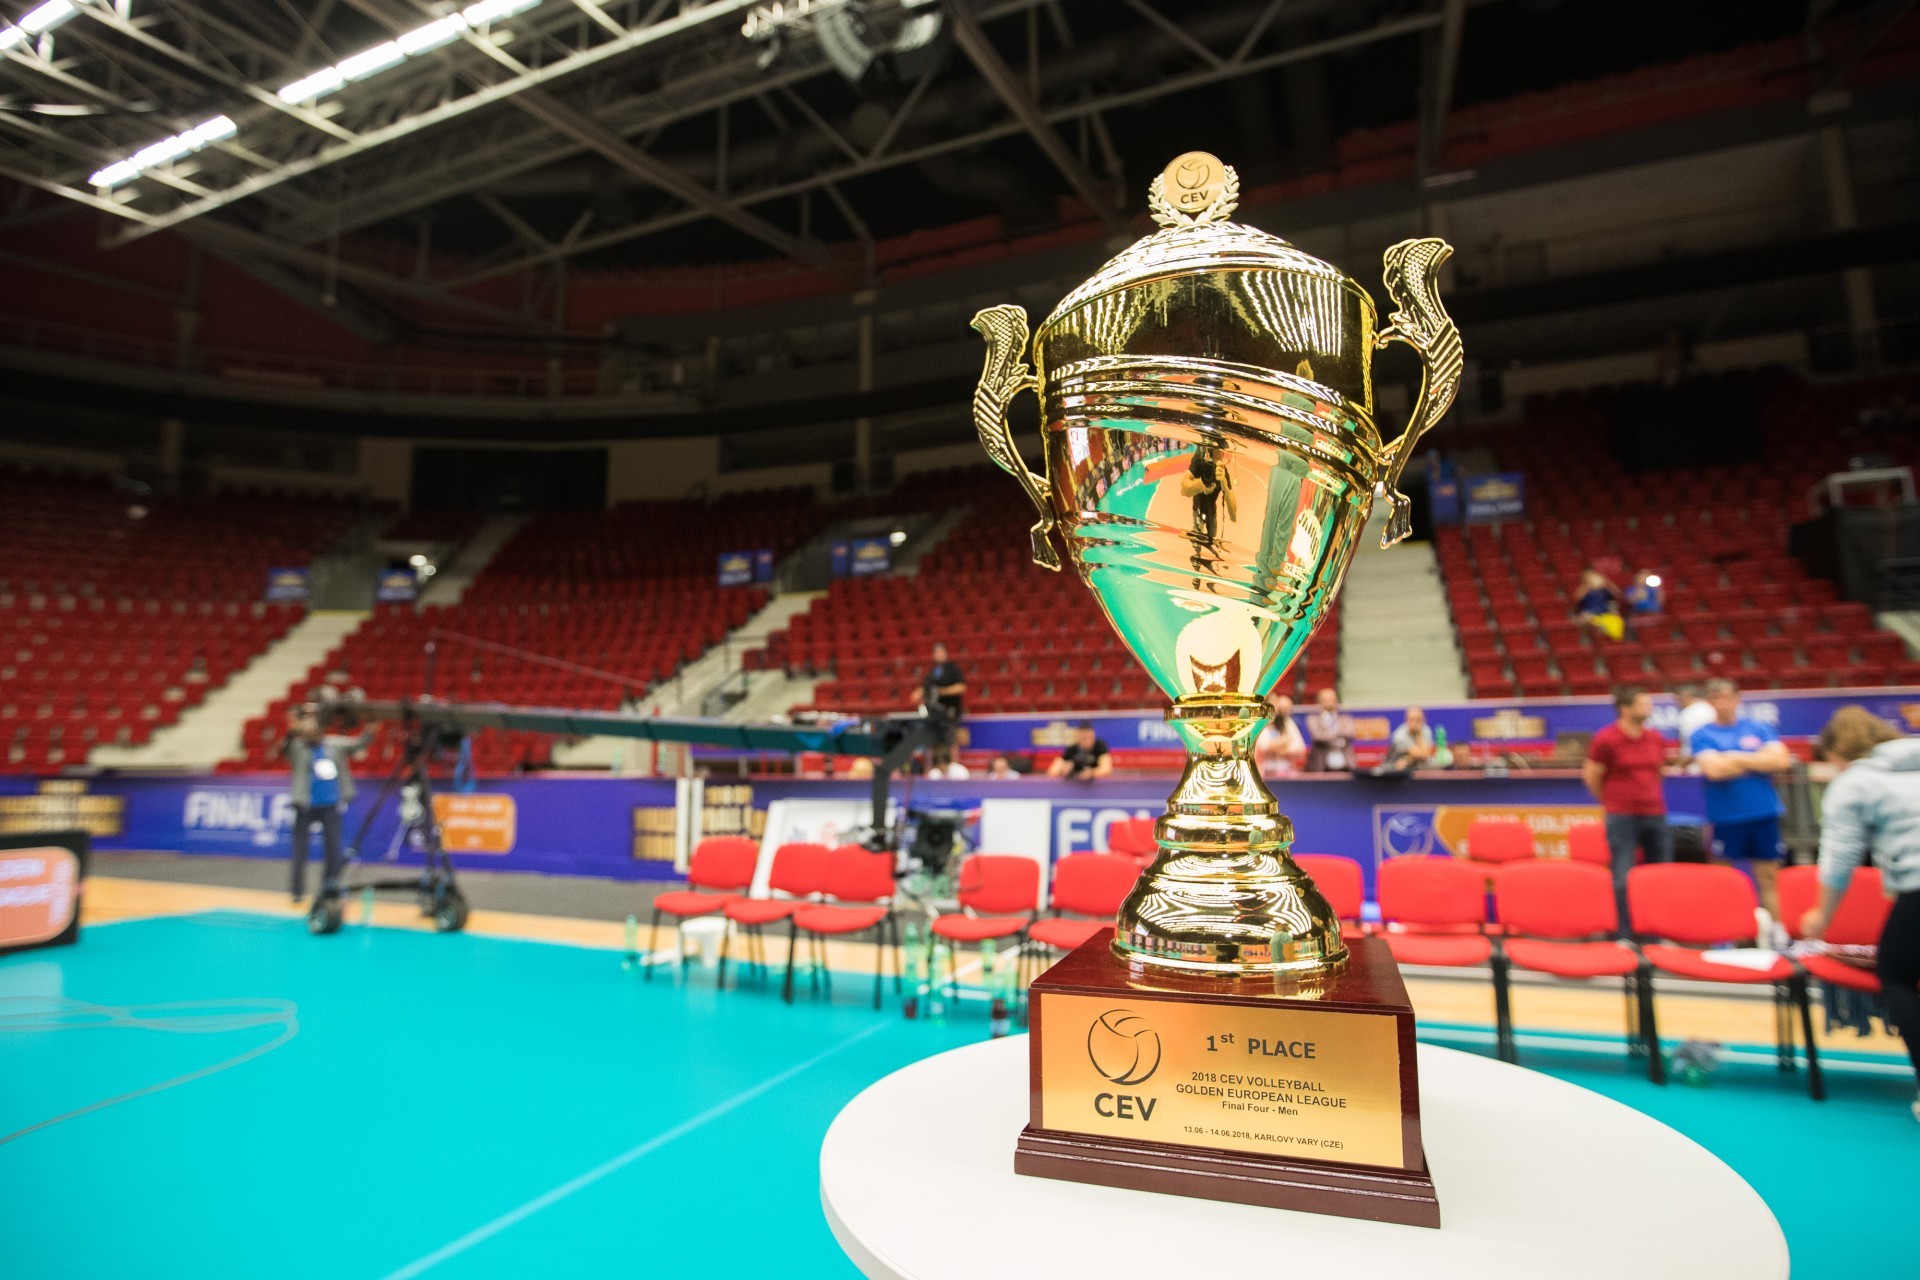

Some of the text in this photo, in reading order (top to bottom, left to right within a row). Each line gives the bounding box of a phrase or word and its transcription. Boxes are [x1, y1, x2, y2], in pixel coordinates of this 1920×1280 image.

[1180, 190, 1209, 204] CEV
[1207, 1033, 1316, 1059] 1st PLACE
[1191, 1072, 1325, 1092] 2018 CEV VOLLEYBALL
[1094, 1092, 1157, 1121] CEV
[1176, 1083, 1347, 1108] GOLDEN EUROPEAN LEAGUE
[1222, 1101, 1245, 1111] Final
[1247, 1103, 1269, 1113] Four
[1278, 1106, 1298, 1116] Men
[1184, 1126, 1203, 1134] 13.06
[1210, 1128, 1253, 1140] 14.06.2018,
[1254, 1133, 1294, 1144] KARLOVY
[1296, 1137, 1318, 1147] VARY
[1320, 1140, 1344, 1150] (CZE)
